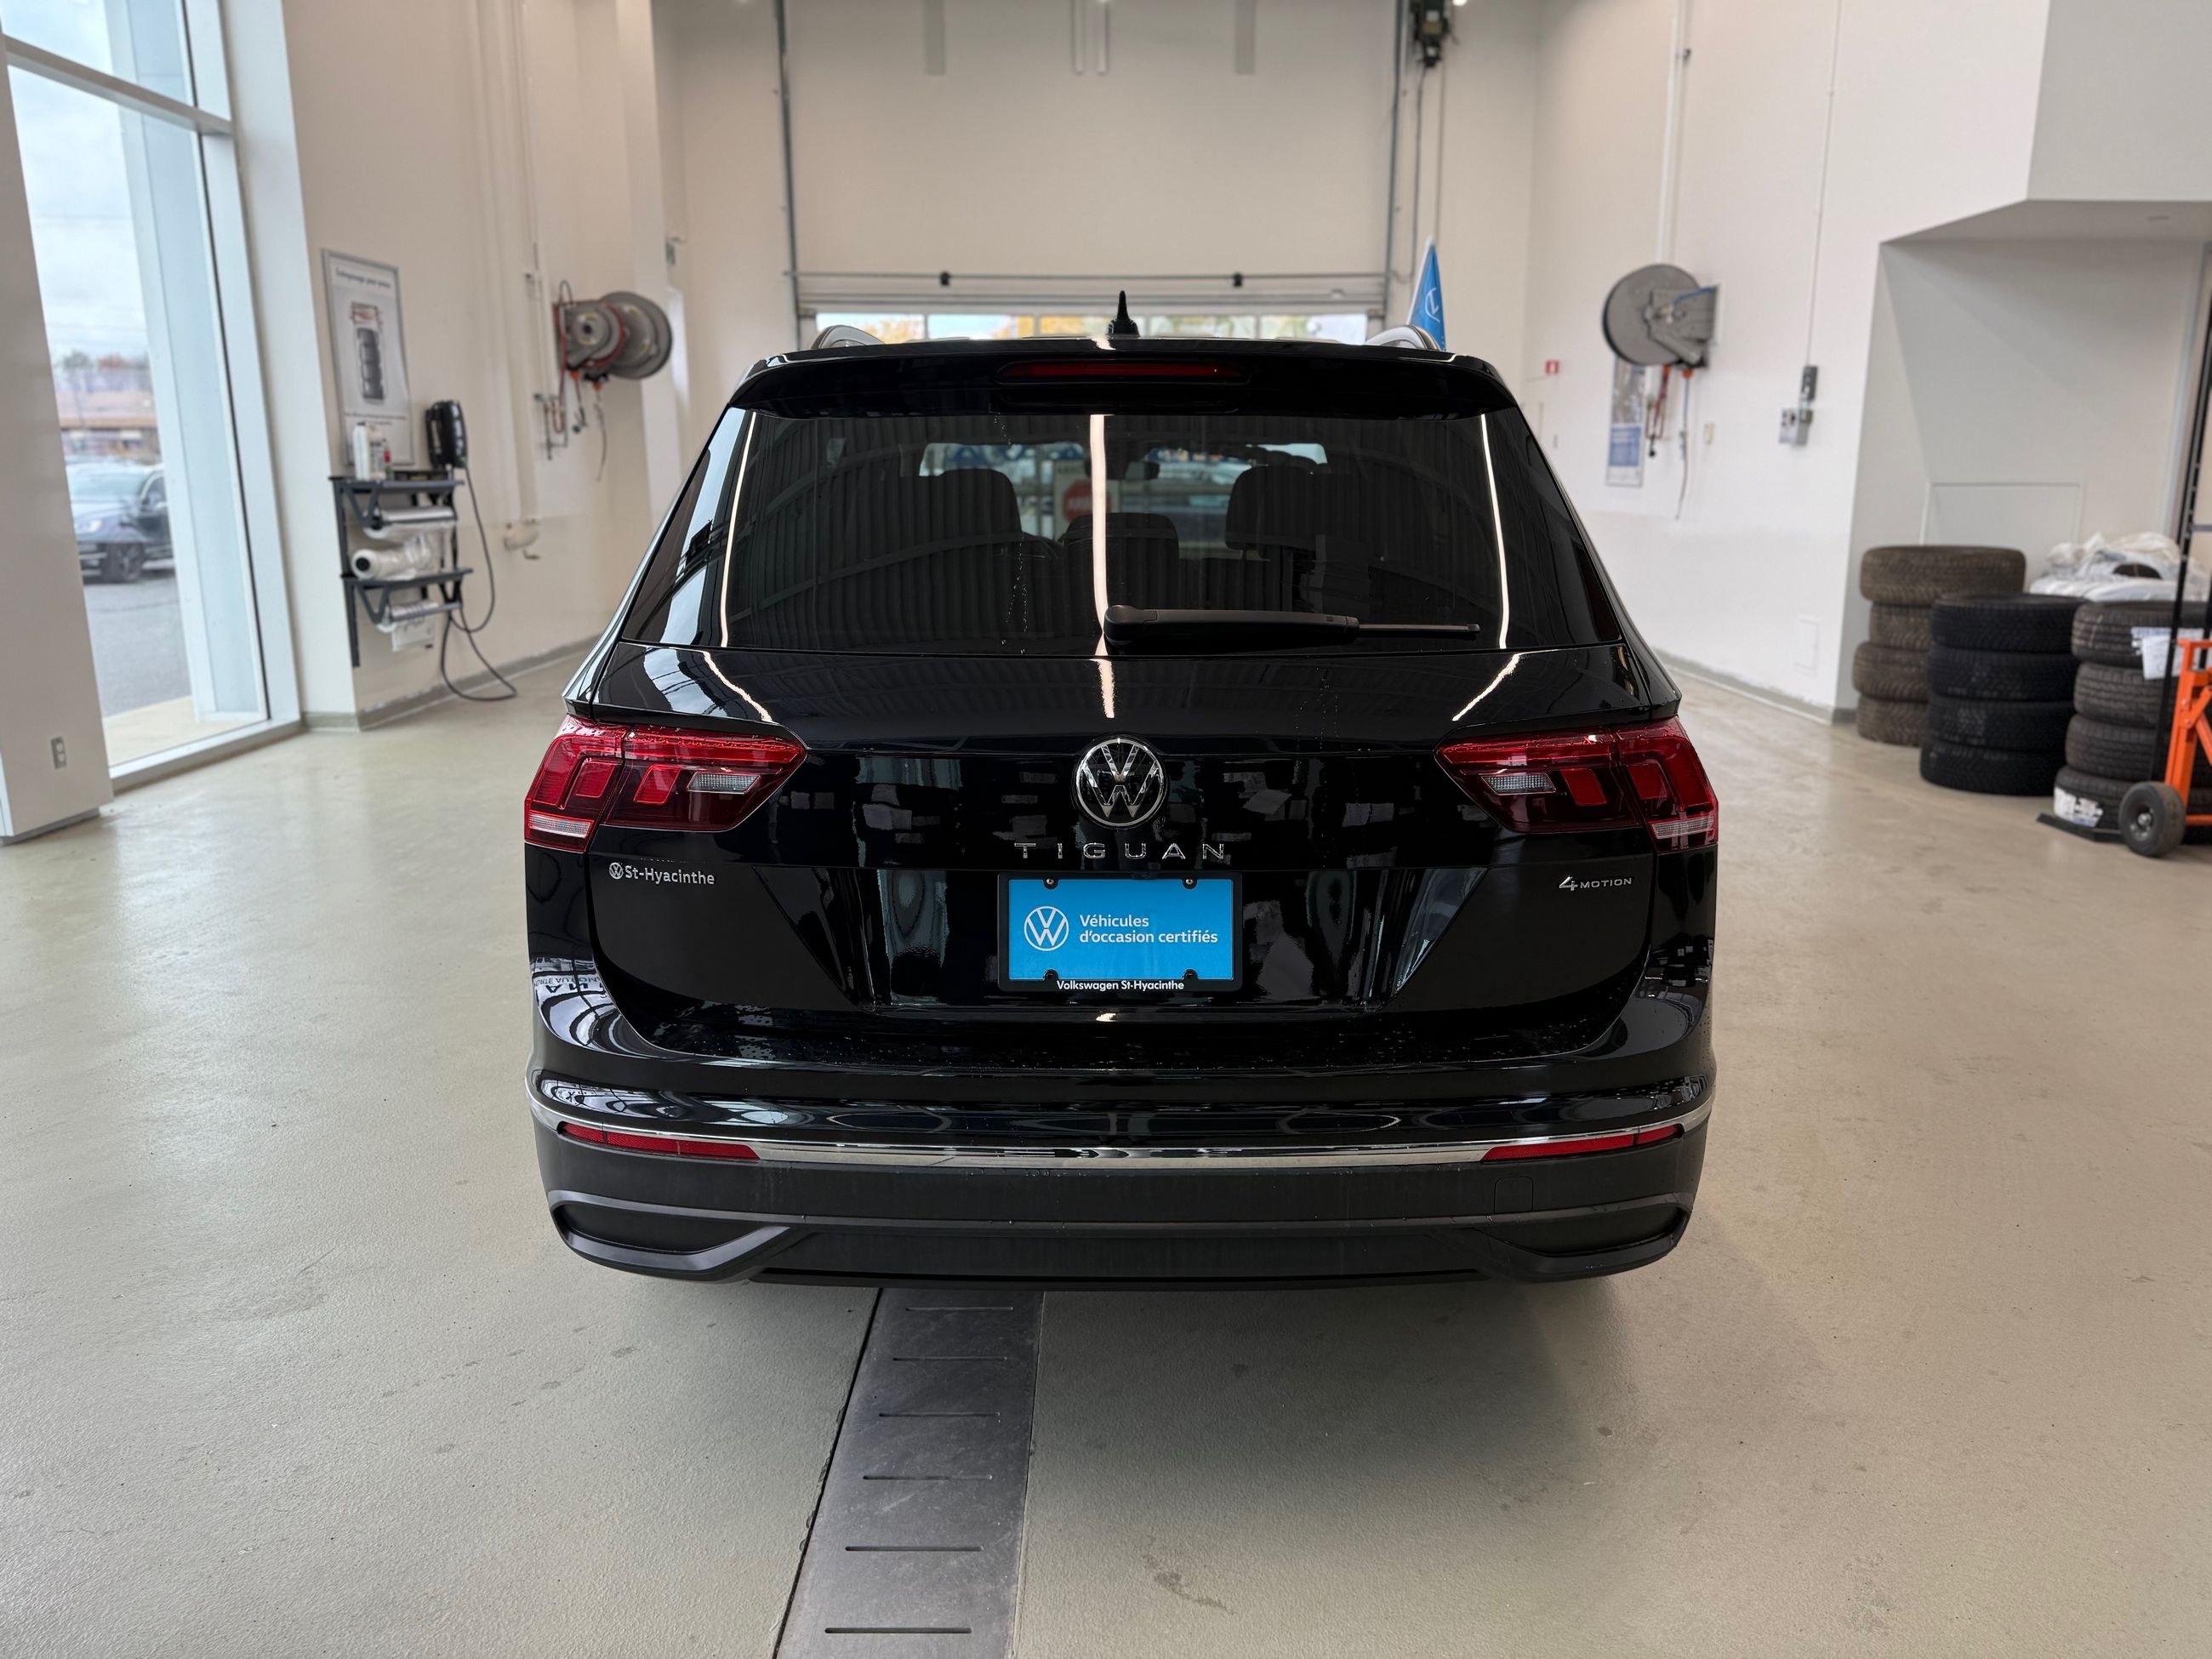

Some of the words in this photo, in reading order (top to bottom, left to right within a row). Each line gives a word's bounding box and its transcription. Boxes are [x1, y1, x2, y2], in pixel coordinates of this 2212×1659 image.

[1014, 842, 1223, 859] TIGUAN
[624, 865, 715, 885] St-Hyacinthe
[1080, 915, 1149, 927] Véhicules
[1080, 930, 1154, 943] d'occasion
[1158, 930, 1218, 943] certifiés
[1057, 980, 1119, 990] Volkswagen
[1120, 980, 1184, 990] St-Hyacinthe
